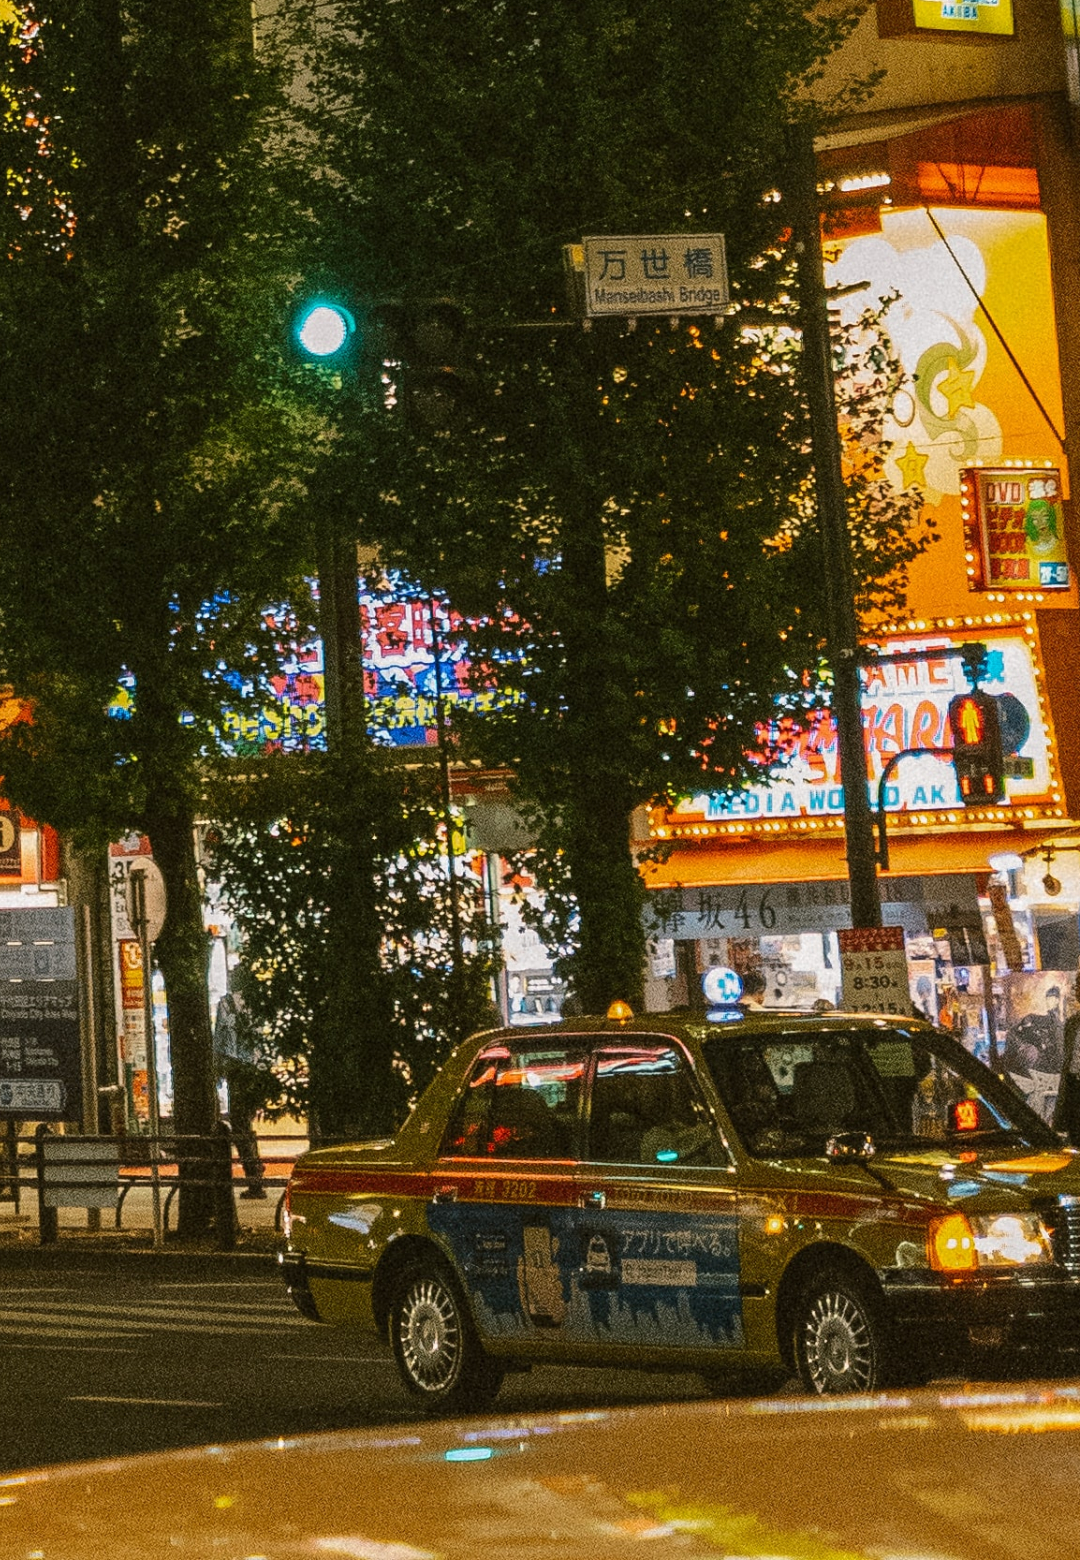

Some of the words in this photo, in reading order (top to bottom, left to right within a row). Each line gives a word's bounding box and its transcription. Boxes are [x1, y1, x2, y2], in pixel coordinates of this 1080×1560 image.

[942, 3, 979, 19] AKIBA
[597, 247, 713, 280] 万世橋
[679, 285, 721, 306] Bridge
[809, 785, 900, 811] WOD
